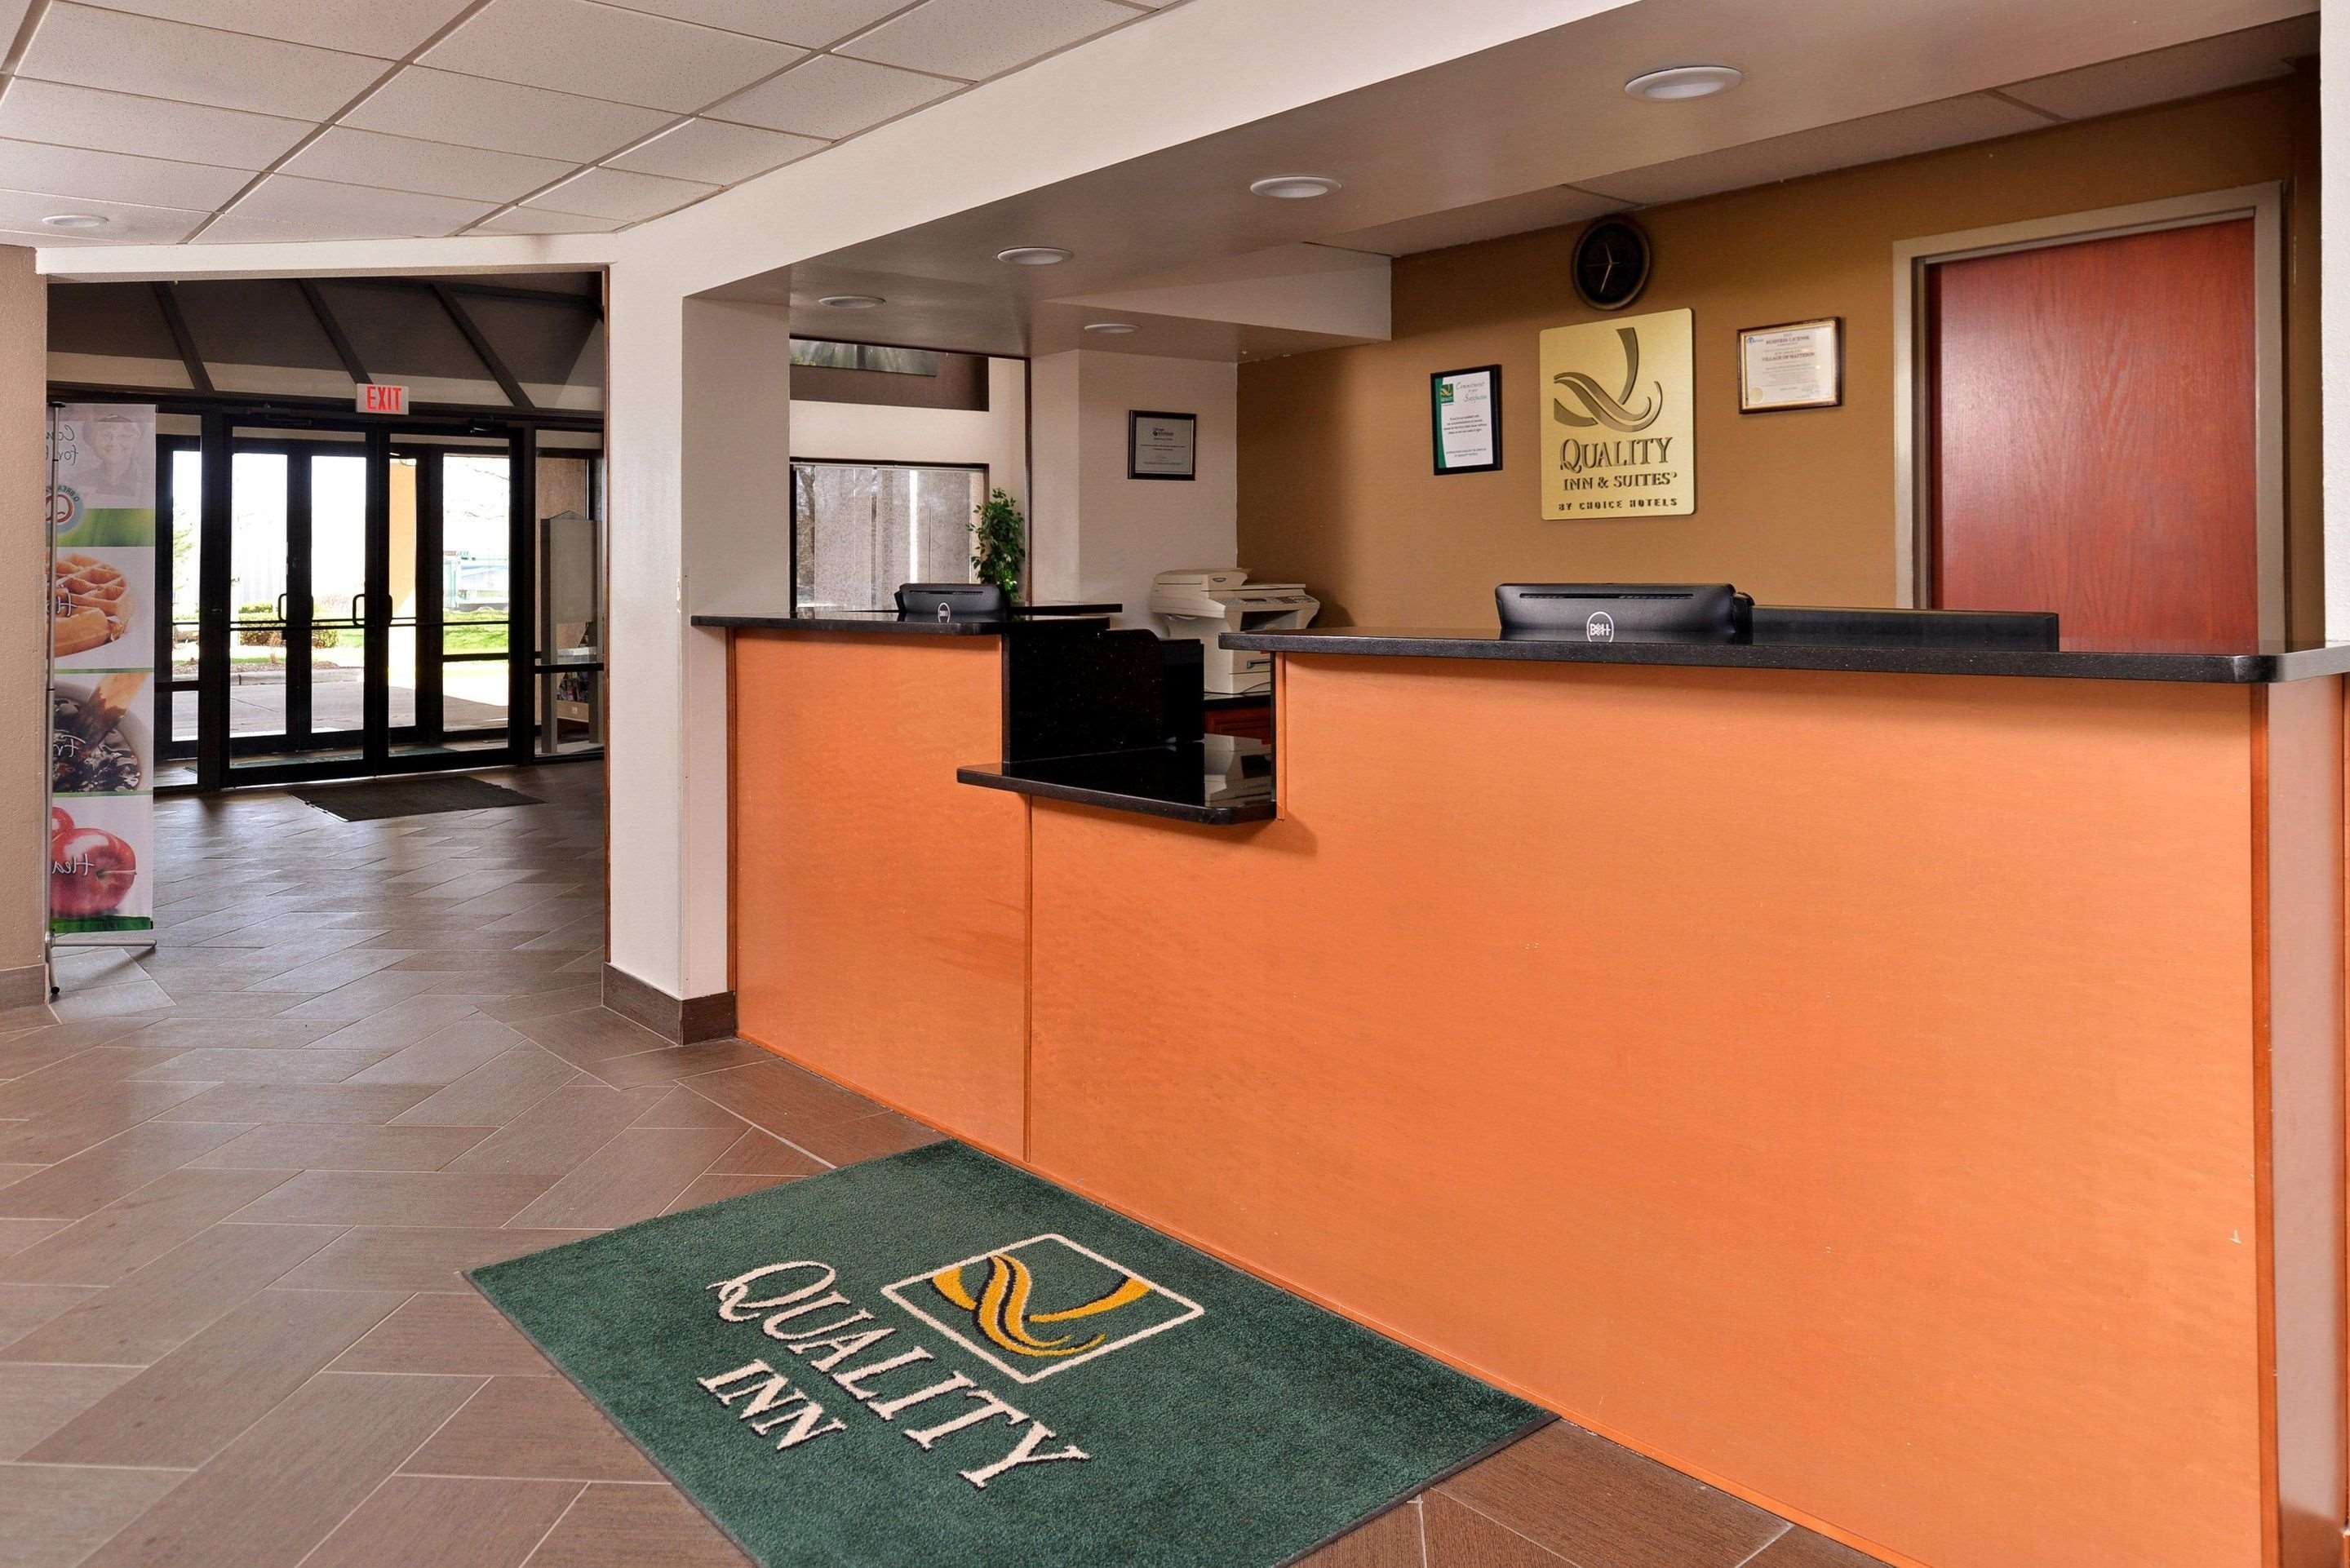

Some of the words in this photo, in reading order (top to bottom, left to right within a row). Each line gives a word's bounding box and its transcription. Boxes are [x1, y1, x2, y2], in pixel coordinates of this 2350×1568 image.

[366, 386, 401, 411] EXIT
[1559, 436, 1673, 474] QUALITY
[1563, 477, 1594, 490] INN
[1598, 476, 1609, 489] &
[1559, 503, 1572, 511] BY
[1579, 500, 1623, 511] CHOICE
[1629, 498, 1678, 508] HOTELS
[706, 1260, 1090, 1490] QUALITY
[697, 1358, 848, 1451] INN
